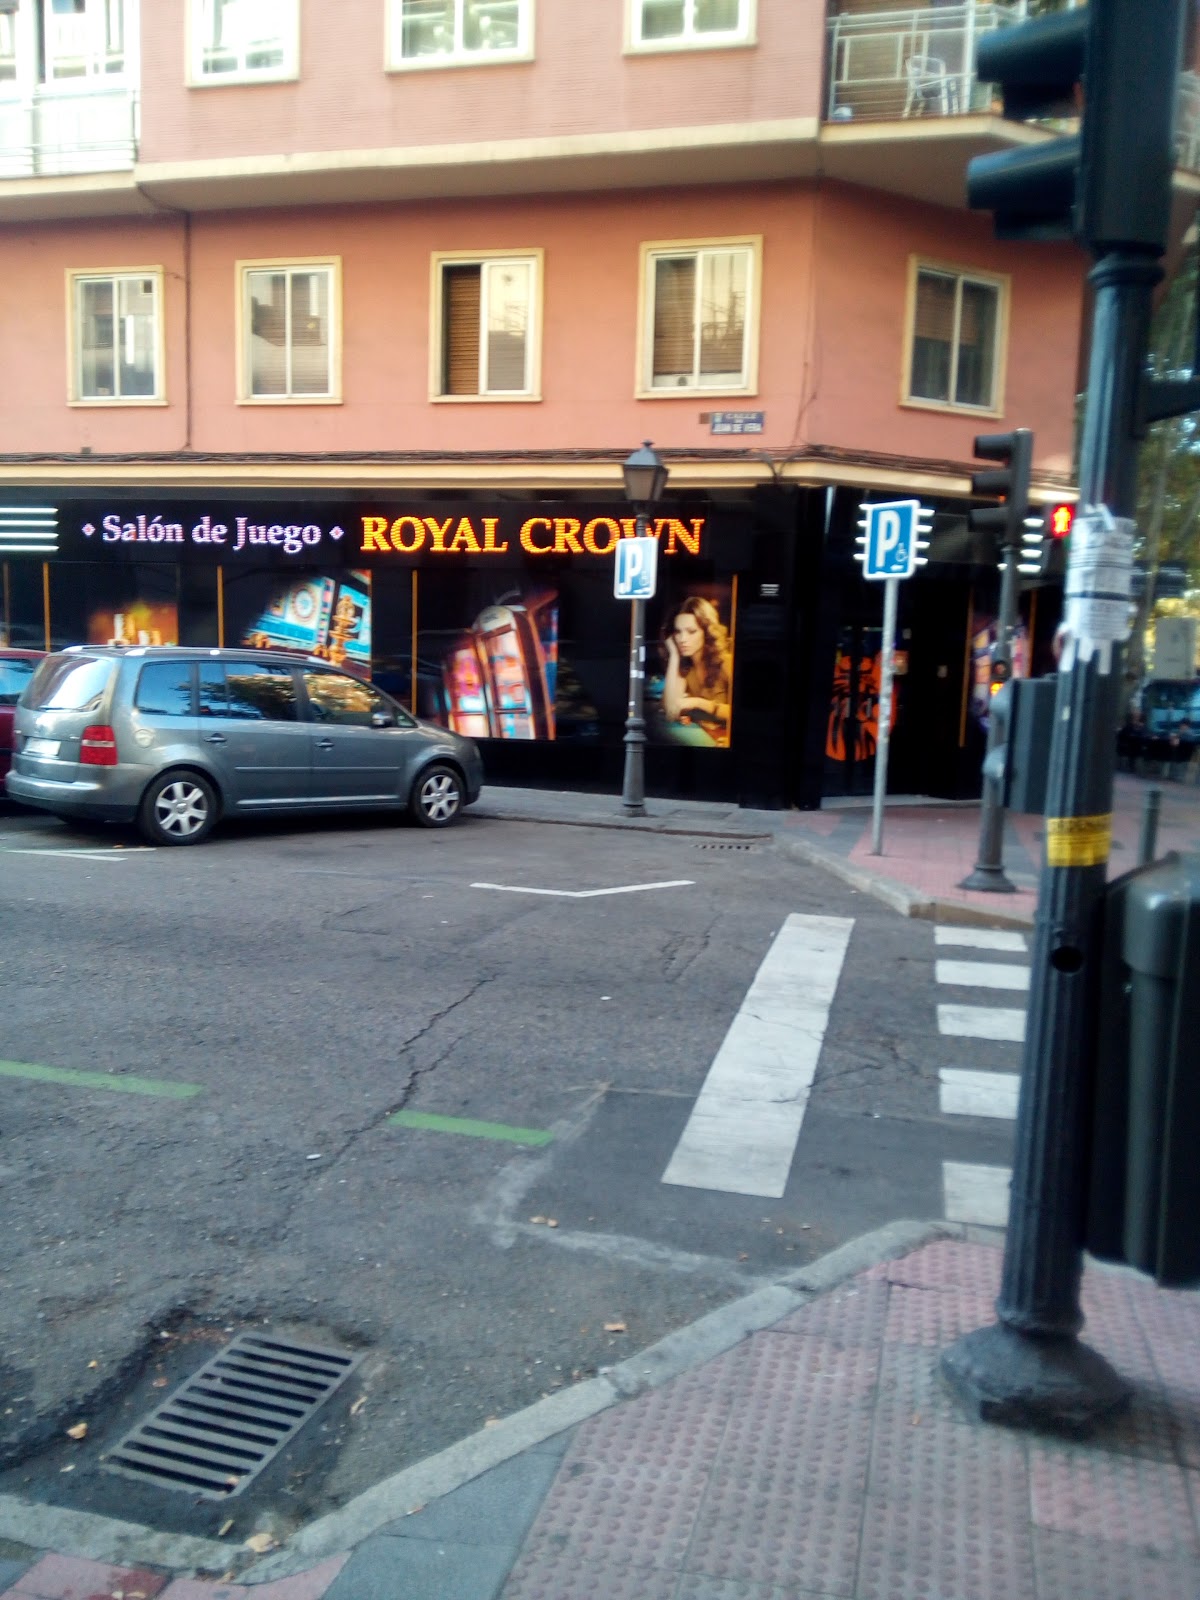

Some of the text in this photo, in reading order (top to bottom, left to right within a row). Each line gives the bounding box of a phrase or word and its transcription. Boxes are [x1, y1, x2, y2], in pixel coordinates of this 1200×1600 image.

[102, 514, 322, 553] Salón de Juego
[360, 516, 508, 553] ROYAL
[876, 510, 901, 568] P
